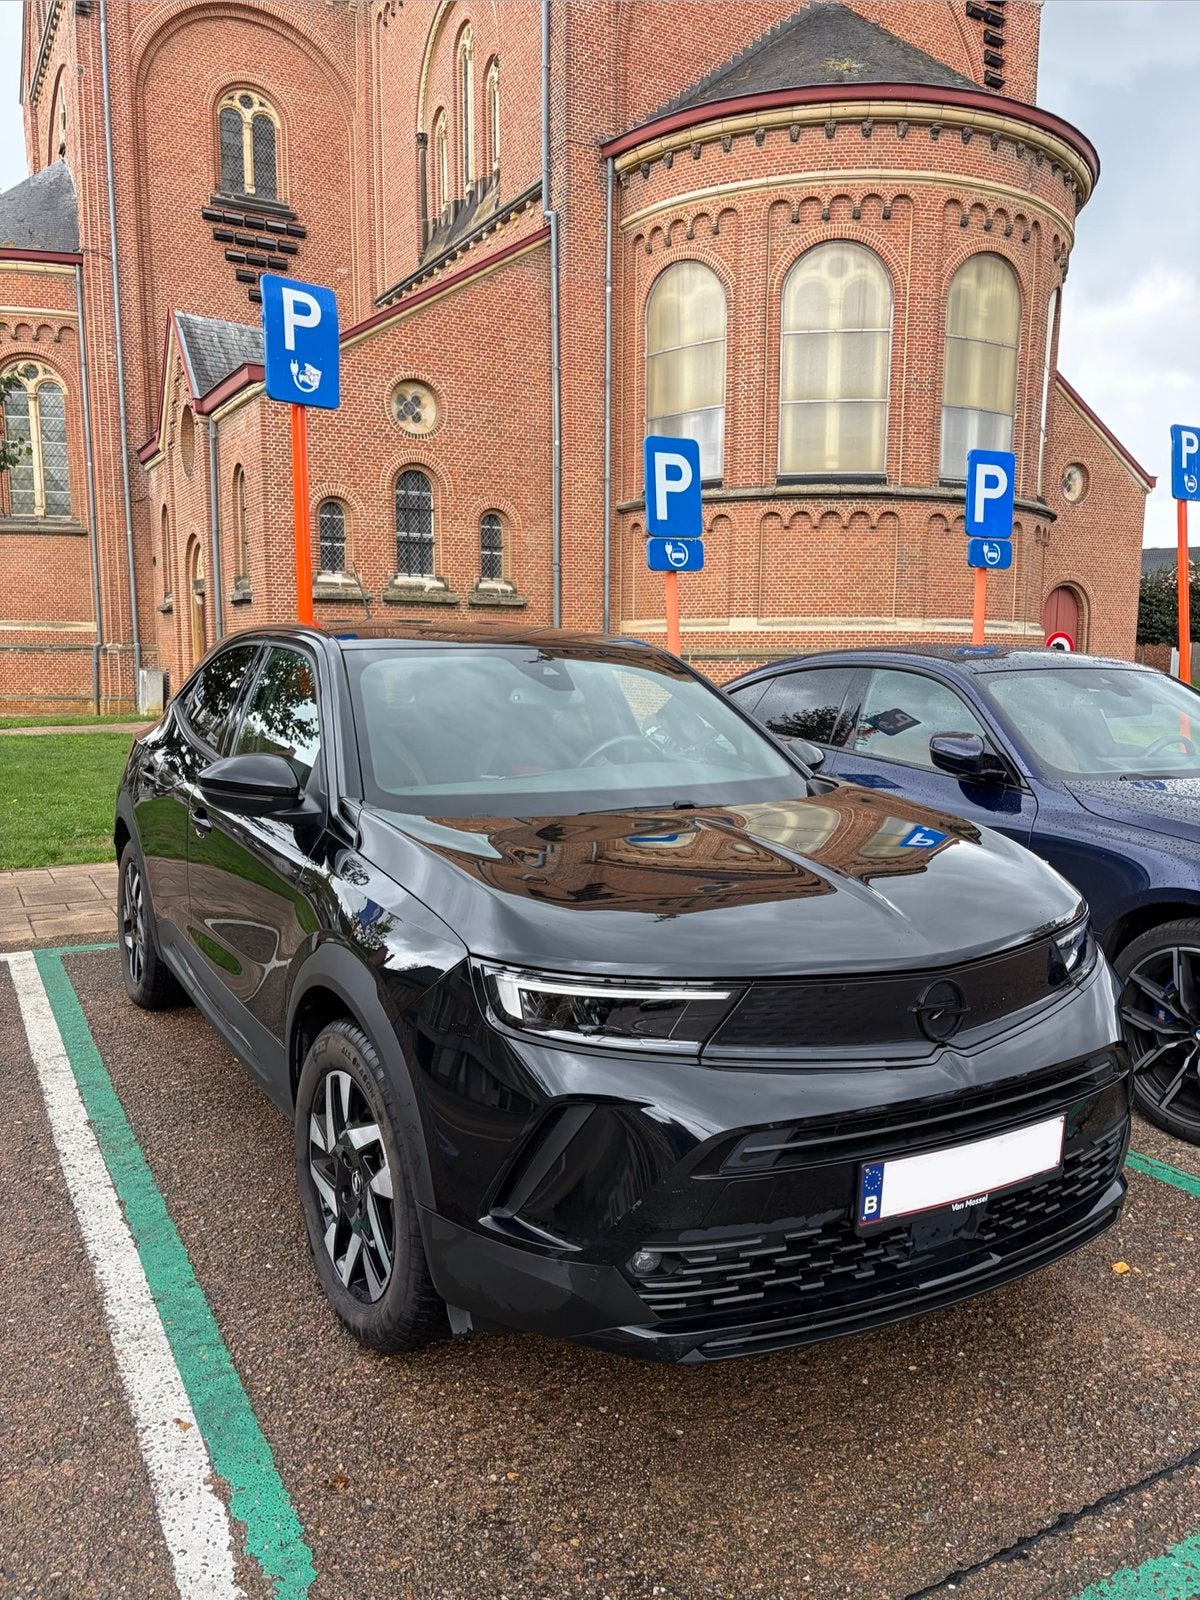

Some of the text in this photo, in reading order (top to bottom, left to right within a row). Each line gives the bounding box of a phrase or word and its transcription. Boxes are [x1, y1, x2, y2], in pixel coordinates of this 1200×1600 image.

[282, 287, 322, 350] P
[1181, 430, 1199, 469] P
[654, 452, 693, 521] P
[974, 463, 1008, 523] P
[863, 1195, 878, 1215] B
[951, 1194, 989, 1211] Van Mossel
